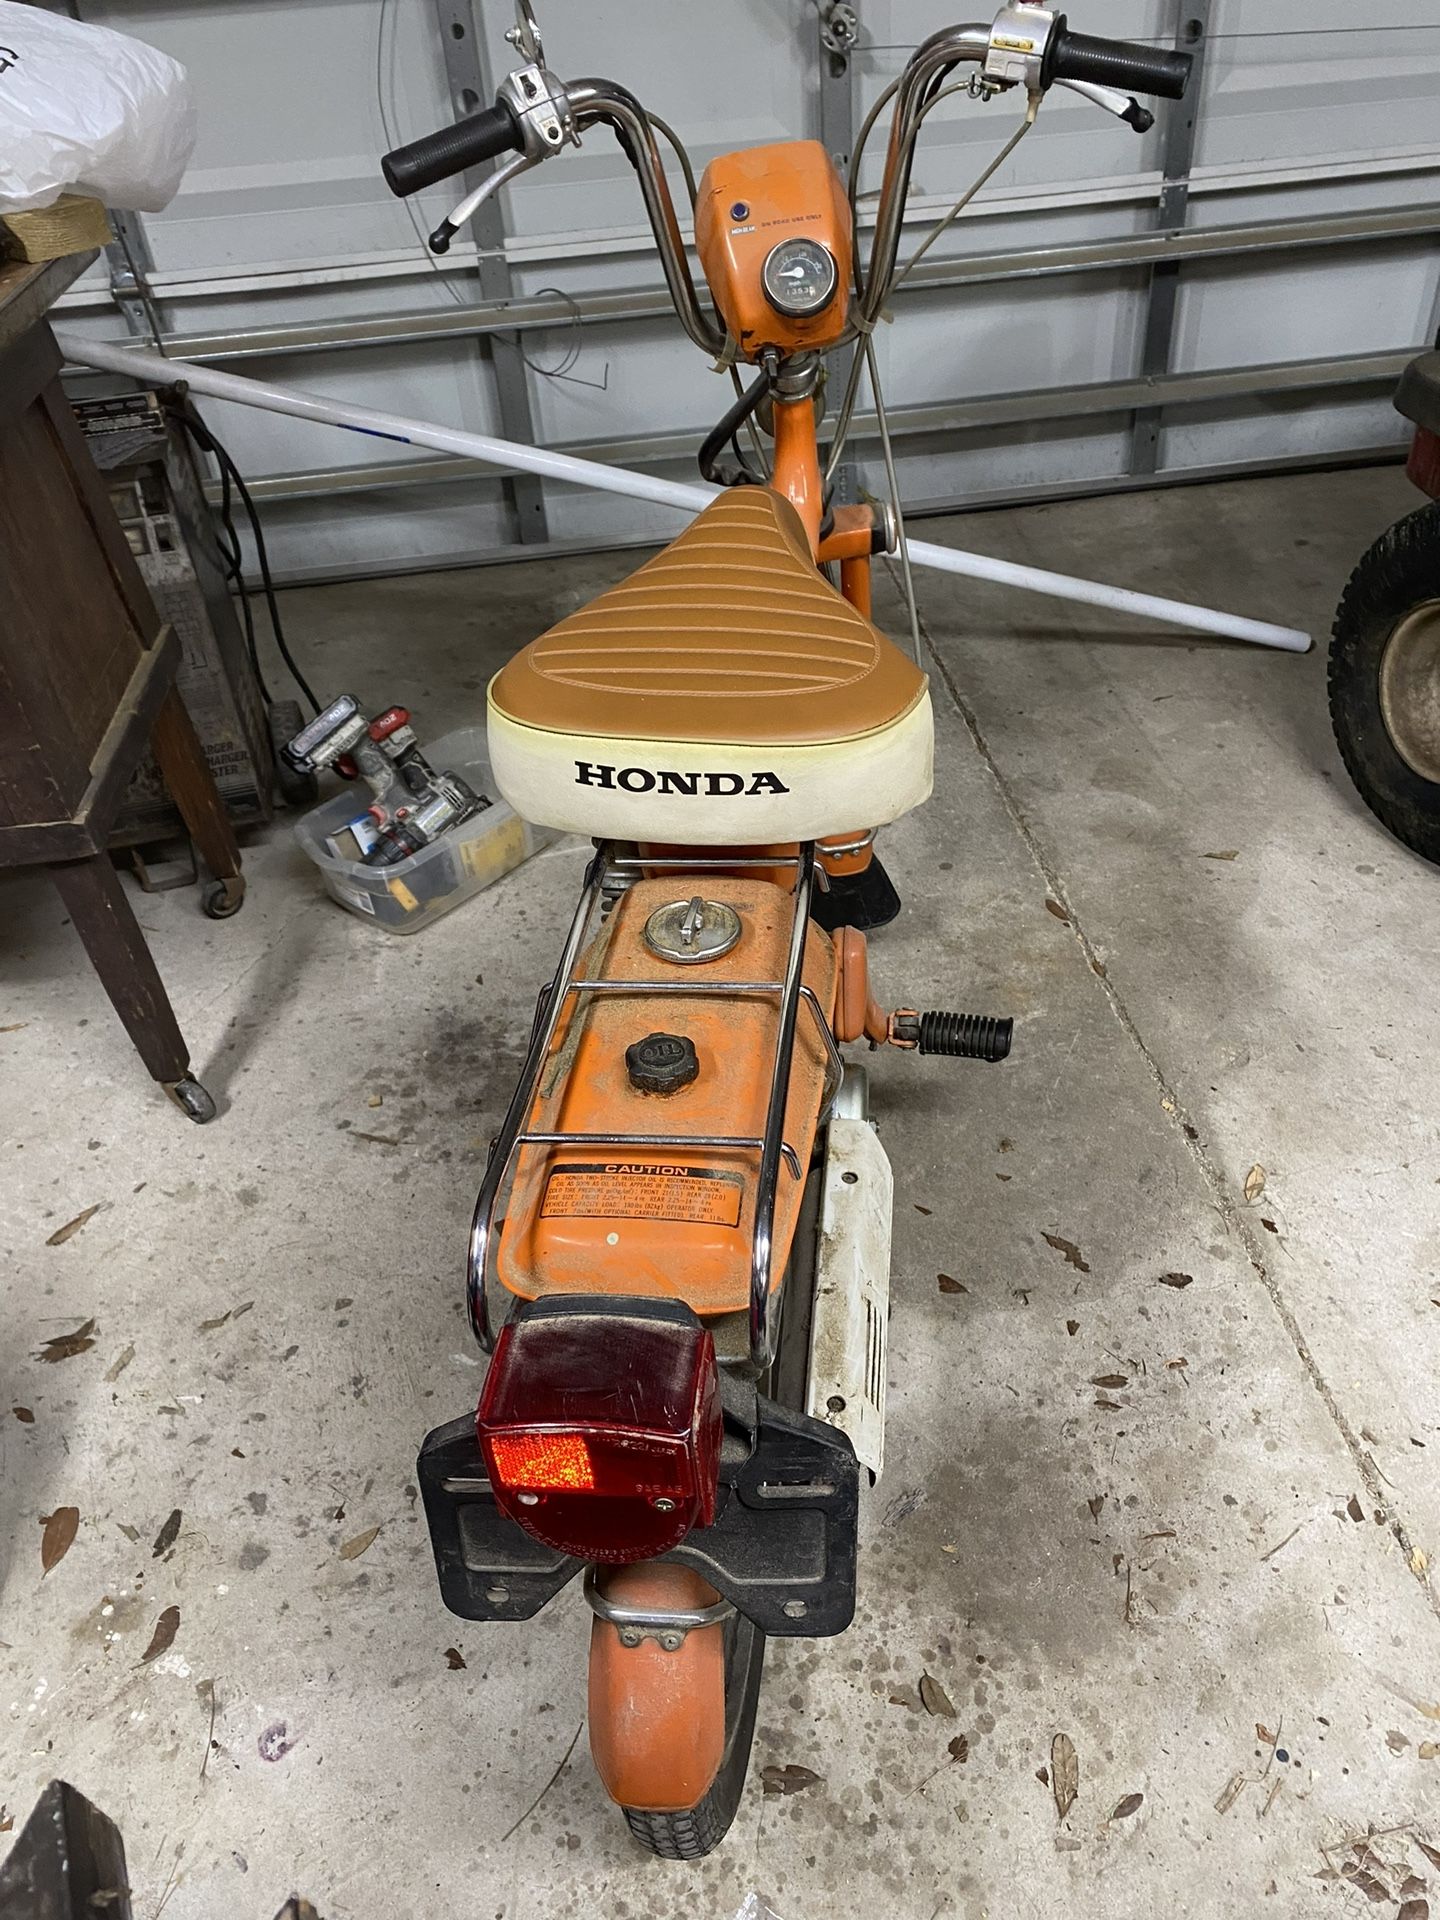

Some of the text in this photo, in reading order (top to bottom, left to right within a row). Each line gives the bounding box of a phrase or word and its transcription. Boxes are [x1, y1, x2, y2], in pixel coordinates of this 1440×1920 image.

[575, 761, 790, 795] HONDA
[643, 1043, 682, 1058] OIL
[604, 1164, 688, 1176] CAUTION
